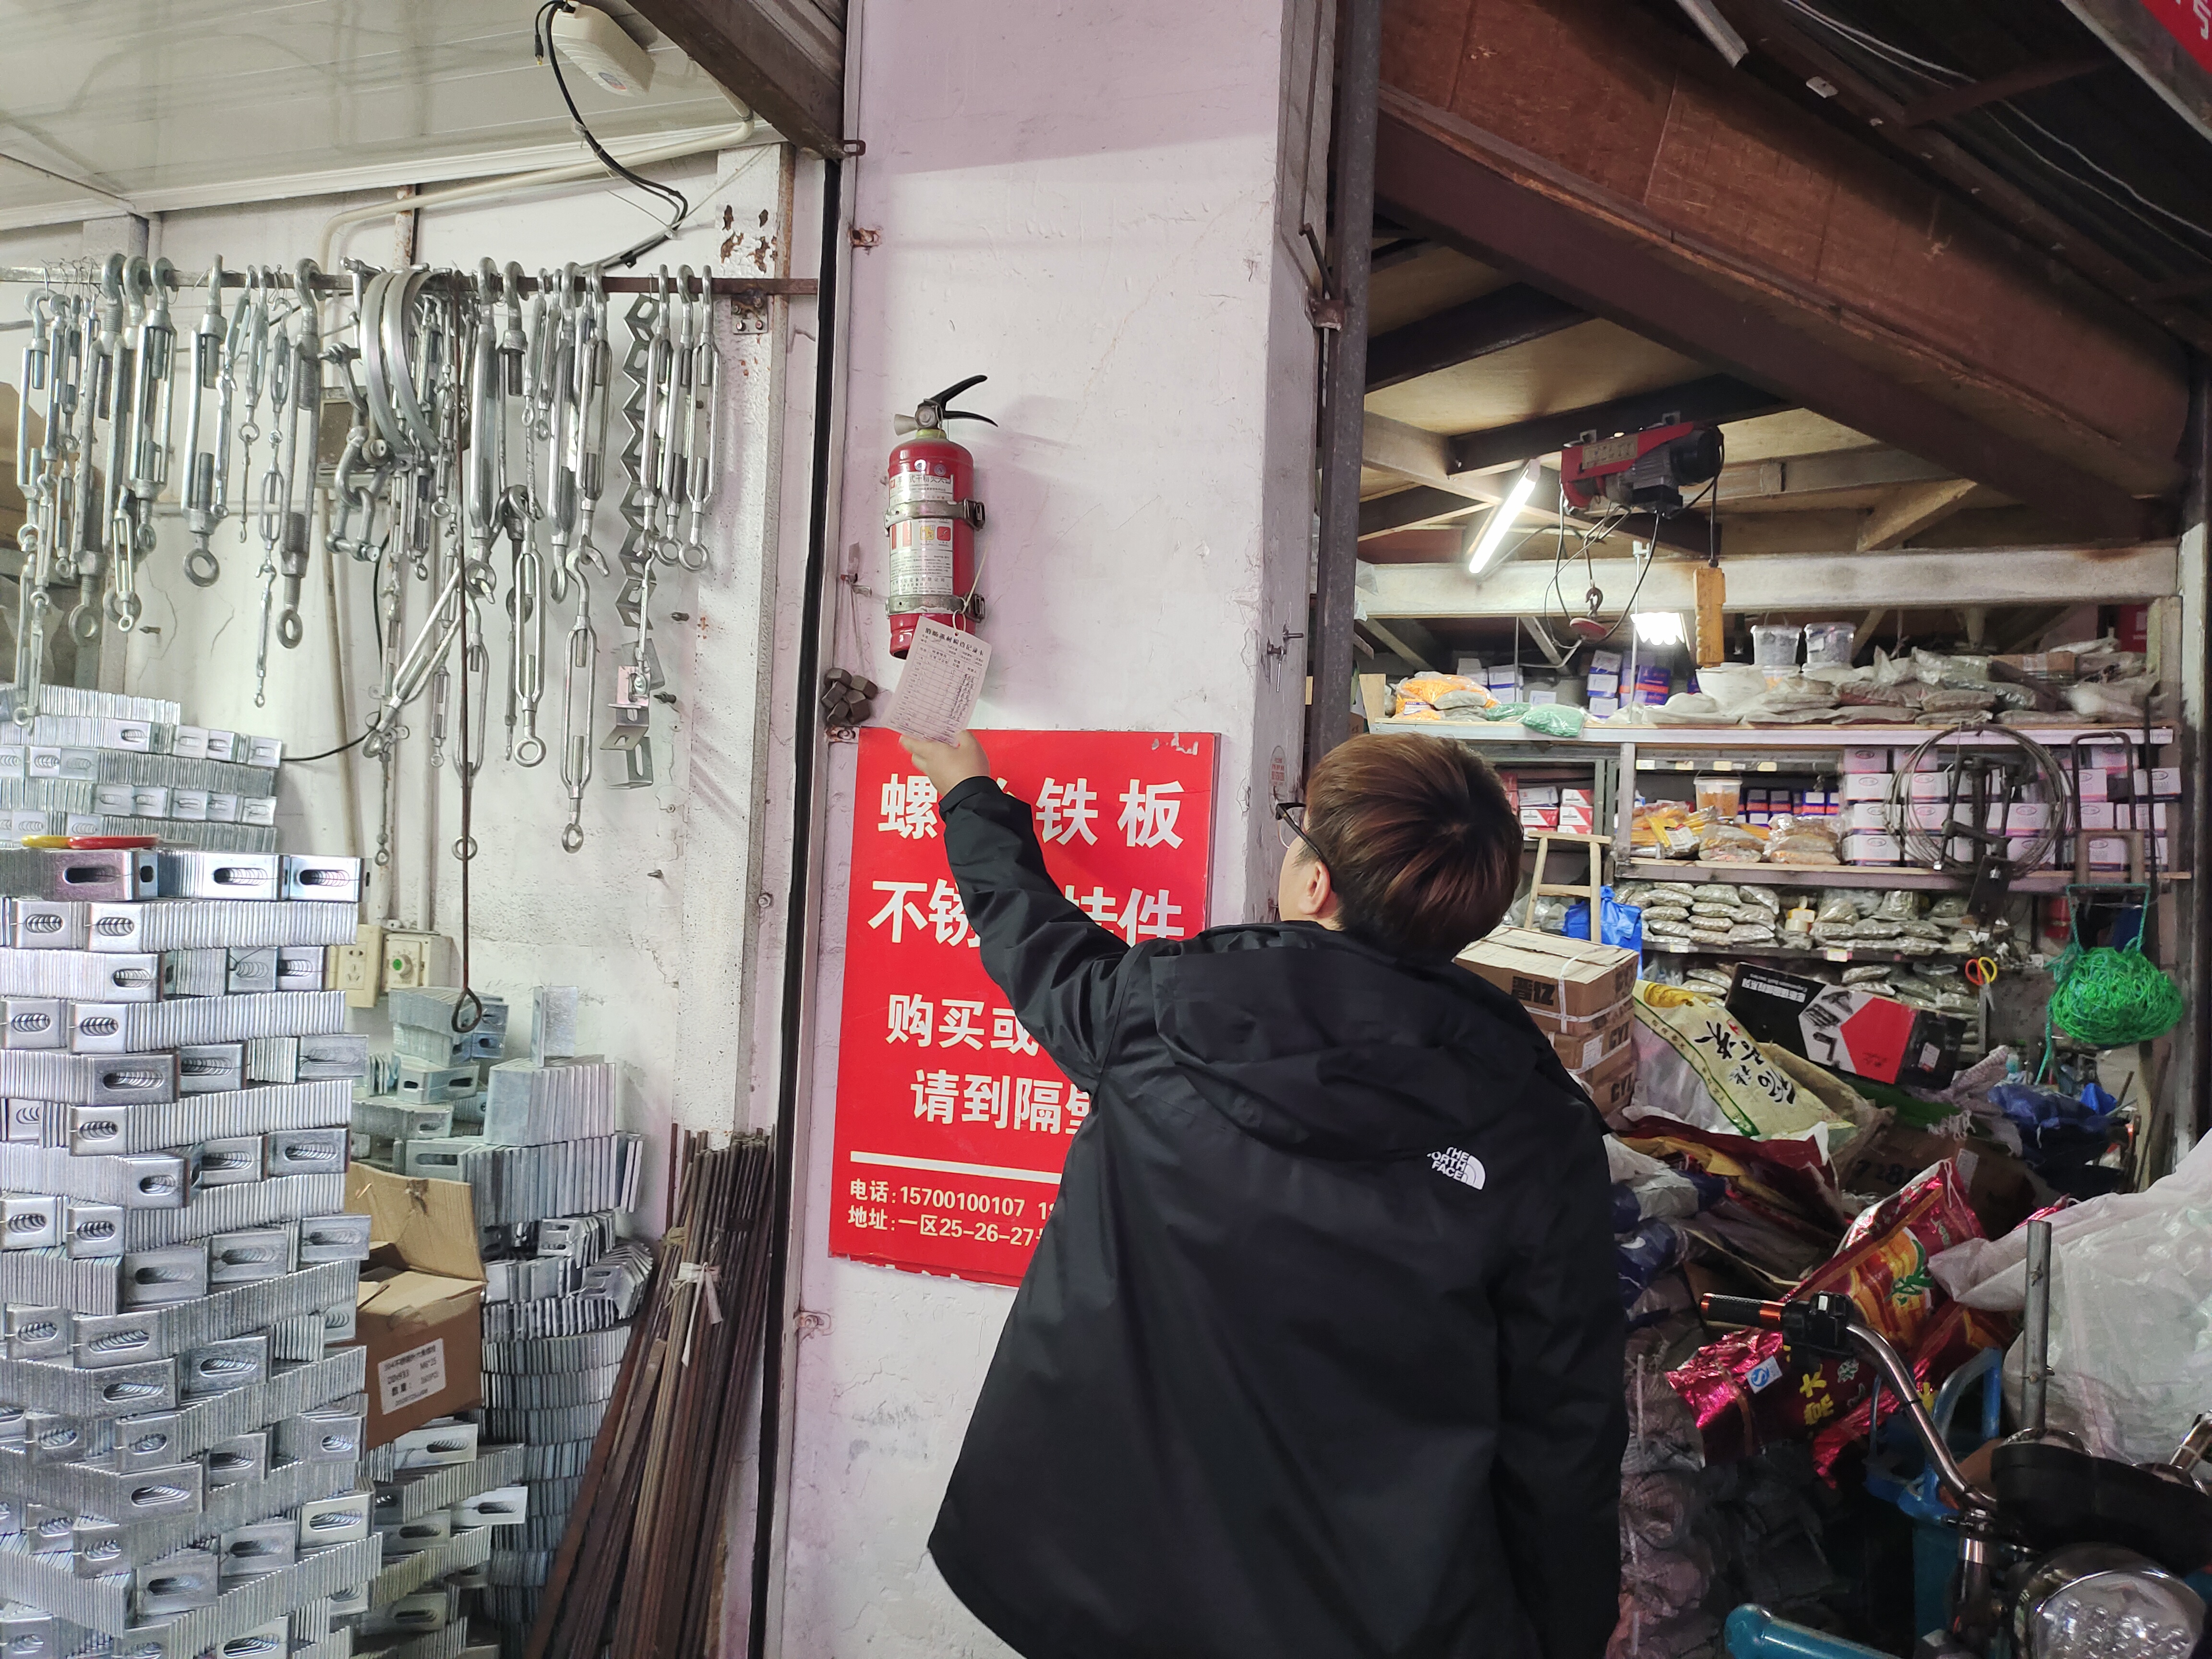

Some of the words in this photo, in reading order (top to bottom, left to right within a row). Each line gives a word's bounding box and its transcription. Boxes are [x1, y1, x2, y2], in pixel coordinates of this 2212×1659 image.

[878, 773, 1184, 849] 螺铁板
[1446, 1146, 1470, 1162] THE
[1431, 1160, 1464, 1181] FACE
